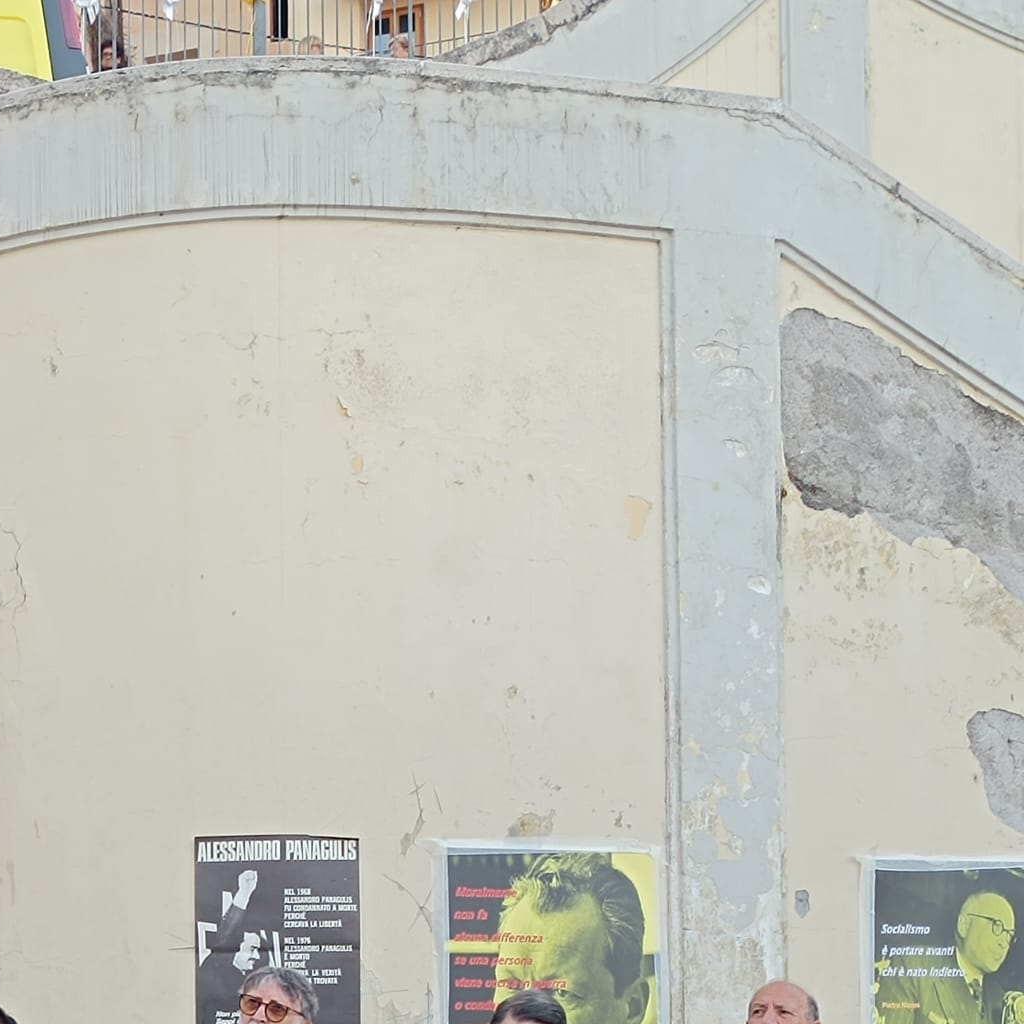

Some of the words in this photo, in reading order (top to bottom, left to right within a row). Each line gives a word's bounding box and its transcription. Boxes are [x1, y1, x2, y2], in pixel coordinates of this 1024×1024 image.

[197, 839, 281, 863] ALESSANDRO
[285, 839, 357, 861] PANAGULIS
[455, 886, 519, 898] Moralmente
[284, 896, 320, 904] ALESSANDRO
[321, 896, 353, 904] PANAGULIS
[293, 904, 331, 912] CONDANNATO
[332, 904, 337, 912] A
[338, 904, 358, 912] MORTE
[453, 910, 474, 920] non
[477, 909, 488, 920] fa
[310, 920, 317, 928] LA
[880, 923, 931, 935] Socialismo
[490, 931, 544, 943] differenza
[881, 945, 888, 955] è
[889, 946, 924, 957] portare
[925, 945, 955, 956] avanti
[454, 957, 466, 966] se
[468, 956, 489, 966] una
[490, 956, 533, 967] persona
[882, 966, 896, 977] chi
[898, 966, 905, 977] è
[906, 967, 928, 977] nato
[454, 1001, 463, 1011] o
